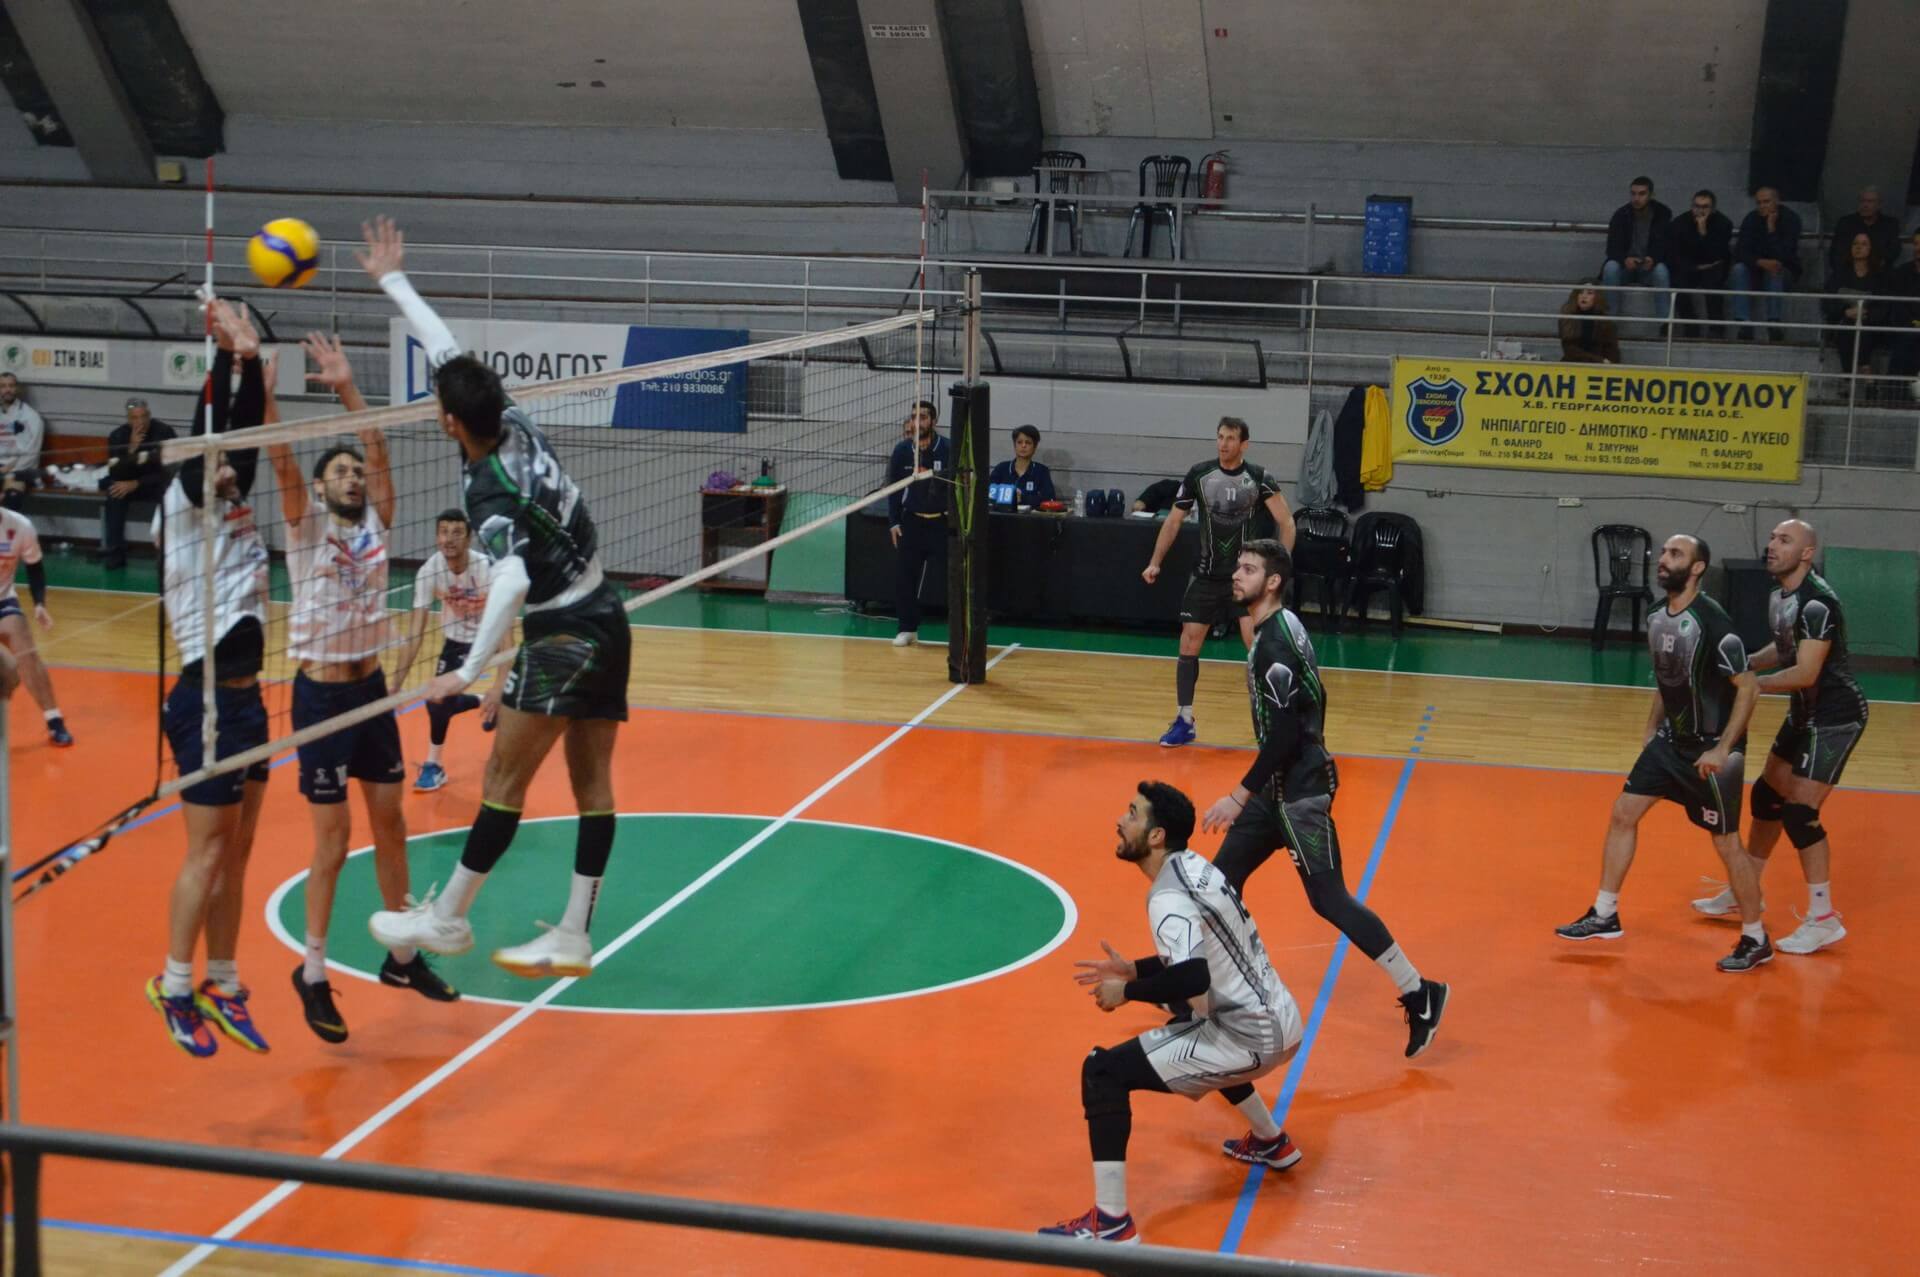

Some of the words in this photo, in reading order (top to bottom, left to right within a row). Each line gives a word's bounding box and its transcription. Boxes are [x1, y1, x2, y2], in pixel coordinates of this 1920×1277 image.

[54, 350, 76, 367] ΣΤΗ
[80, 350, 103, 368] ΒΙΑ!
[662, 382, 680, 392] 210
[1475, 371, 1576, 399] ΣΧΟΛΗ
[1586, 376, 1796, 409] ΞΕΝΟΠΟΥΛΟΥ
[1522, 400, 1548, 409] Χ.Β.
[1552, 402, 1674, 416] ΓΕΩΡΓΑΚΟΠΟΥΛΟΣ
[1679, 408, 1688, 416] &
[1693, 409, 1714, 418] ΣΙΑ
[1718, 410, 1744, 419] Ο.Ε.
[1481, 418, 1566, 435] ΝΗΠΙΑΓΩΓΕΙΟ
[1579, 423, 1648, 439] ΔΗΜΟΤΙΚΟ
[1661, 427, 1729, 443] ΓΥΜΝΑΣΙΟ
[1742, 431, 1790, 446] ΛΥΚΕΙΟ
[1504, 438, 1542, 448] ΦΑΛΗΡΟ
[1598, 443, 1639, 453] ΣΜΥΡΝΗ
[1713, 449, 1752, 459] ΦΑΛΗΡΟ
[1225, 487, 1237, 502] 11
[1662, 633, 1676, 653] 18
[1801, 753, 1810, 769] 1
[1701, 806, 1719, 826] 18
